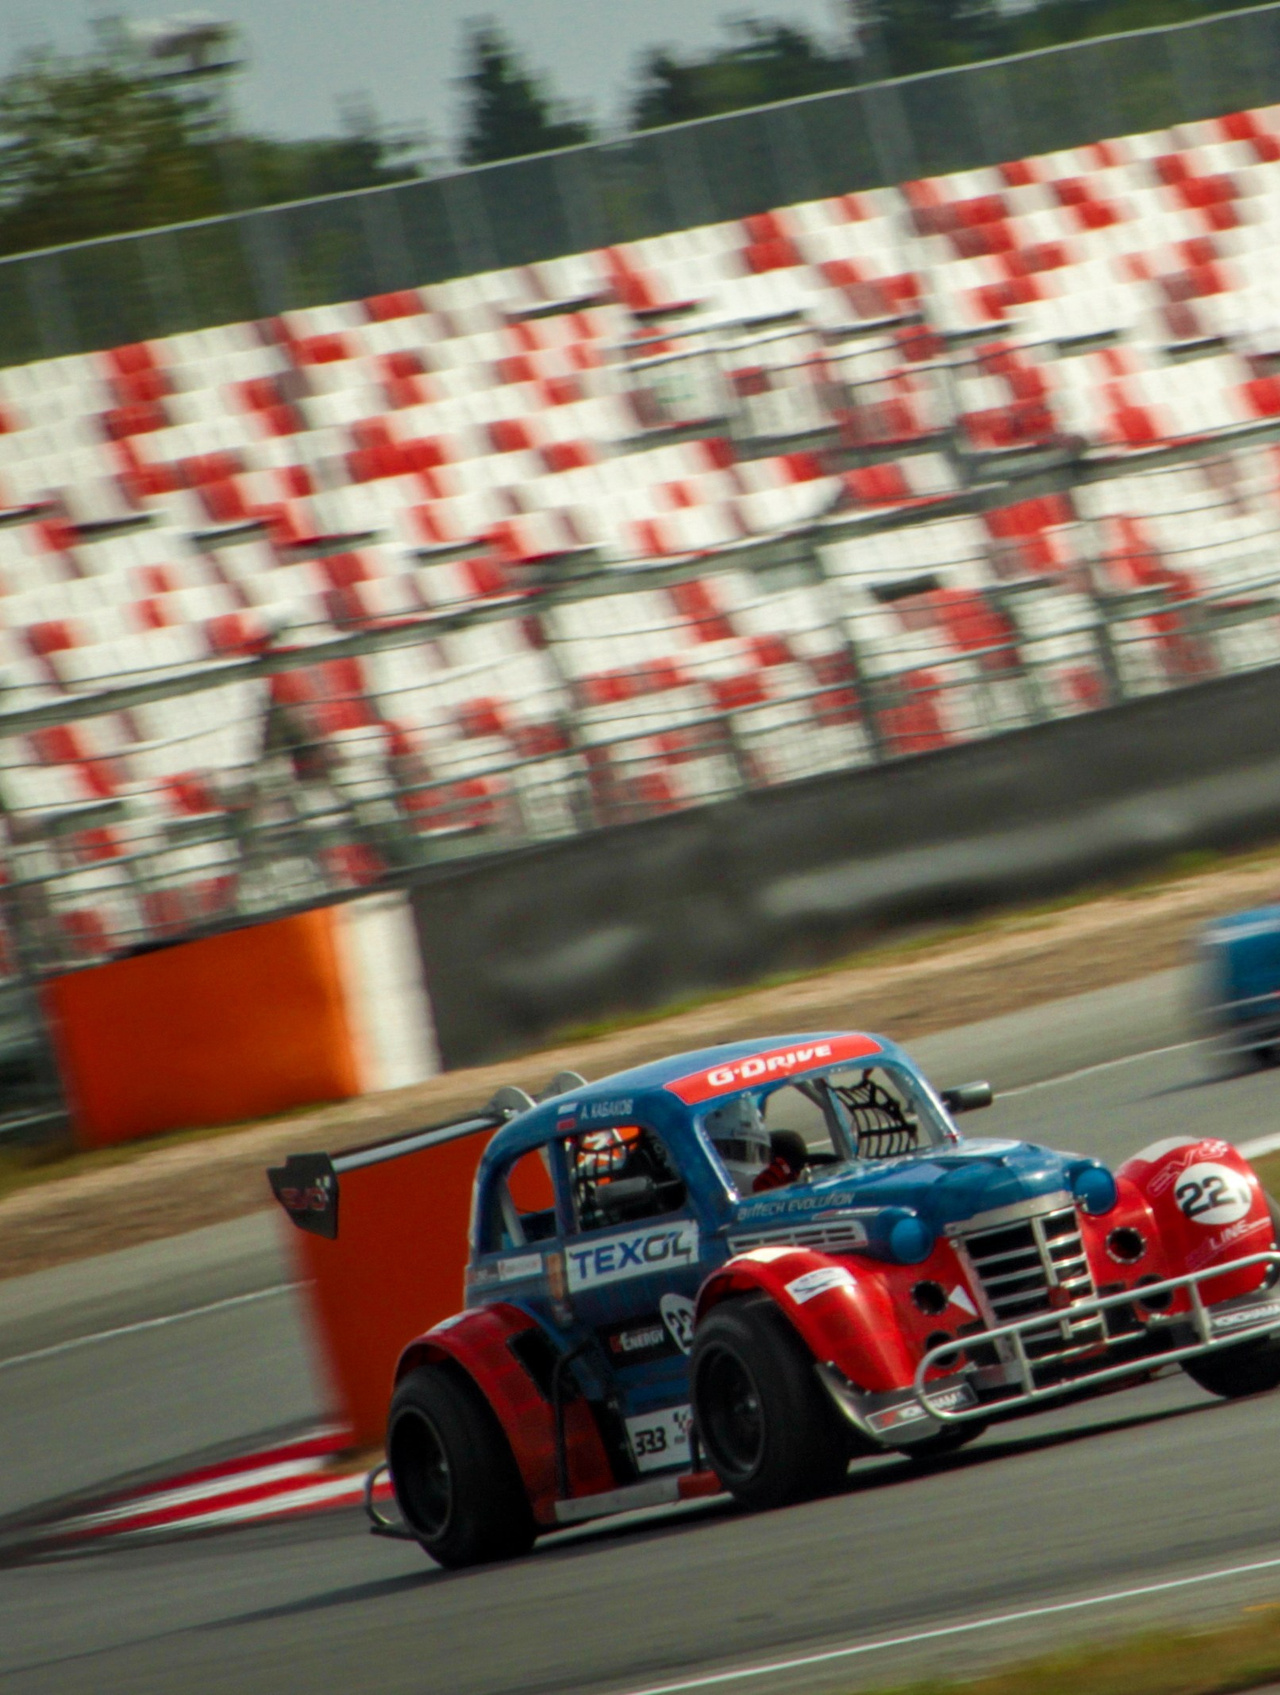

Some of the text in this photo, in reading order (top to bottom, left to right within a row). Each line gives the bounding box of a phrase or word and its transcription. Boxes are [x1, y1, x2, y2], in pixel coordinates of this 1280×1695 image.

[1176, 1175, 1236, 1217] 22
[569, 1230, 692, 1280] TEXOL
[635, 1426, 666, 1457] 333
